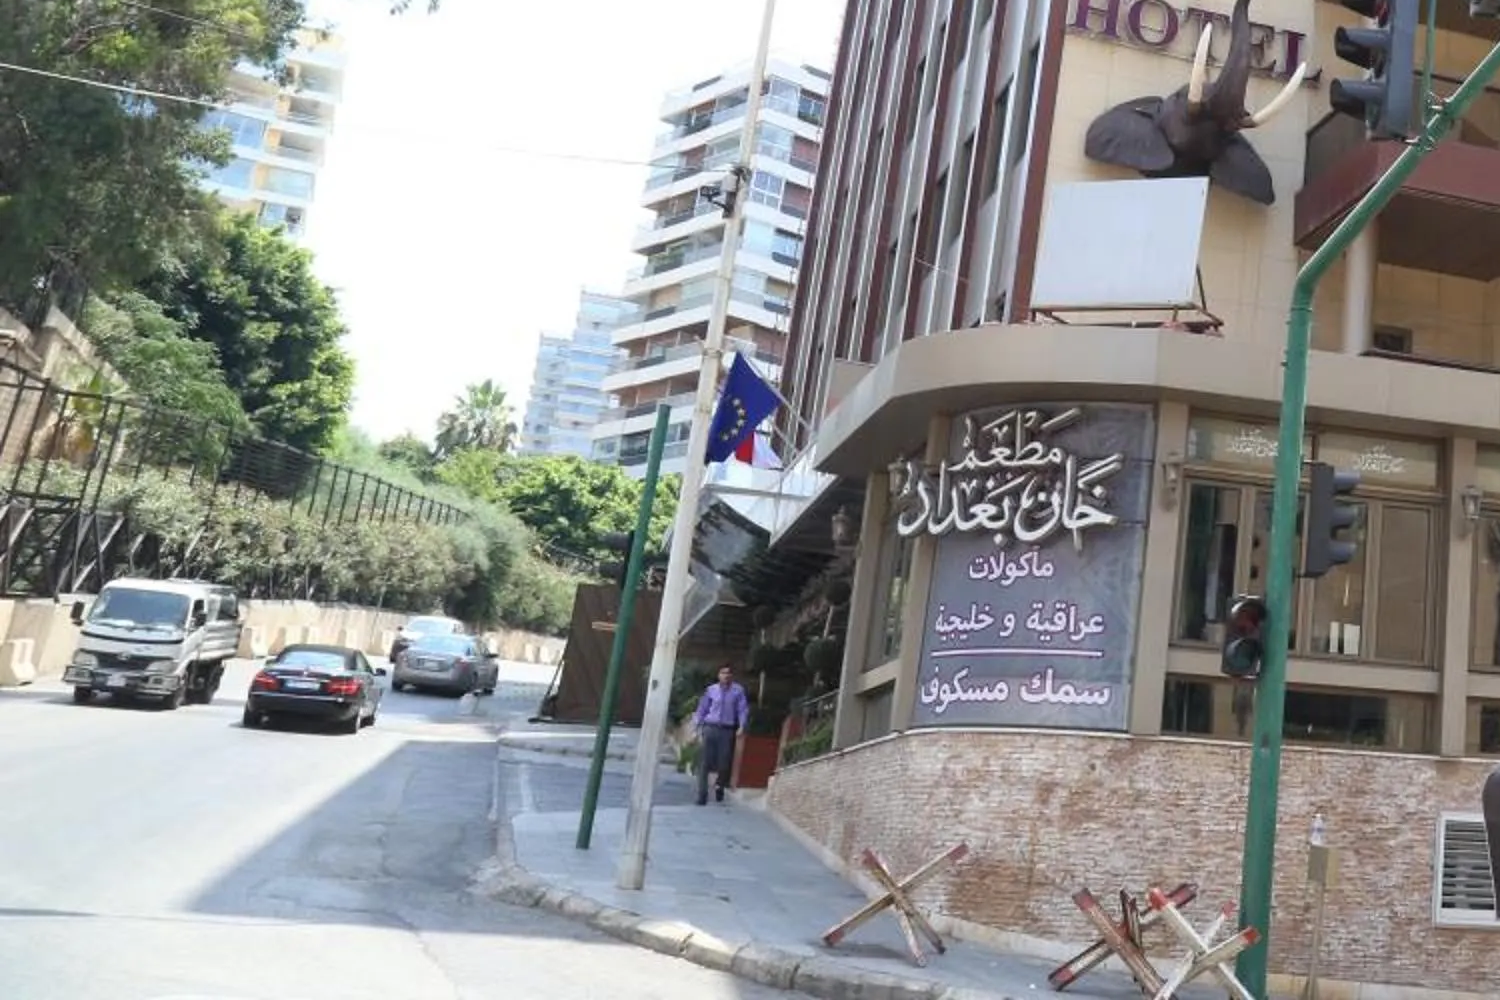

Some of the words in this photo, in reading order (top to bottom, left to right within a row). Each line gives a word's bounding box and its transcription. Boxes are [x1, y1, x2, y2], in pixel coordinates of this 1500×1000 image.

[948, 407, 1080, 471] مطعم
[897, 457, 1022, 544] بغداد
[1013, 453, 1121, 550] خان
[999, 612, 1016, 637] و
[1026, 602, 1105, 641] عراقية
[921, 666, 1010, 713] مسكوف
[1020, 668, 1111, 705] سمك
